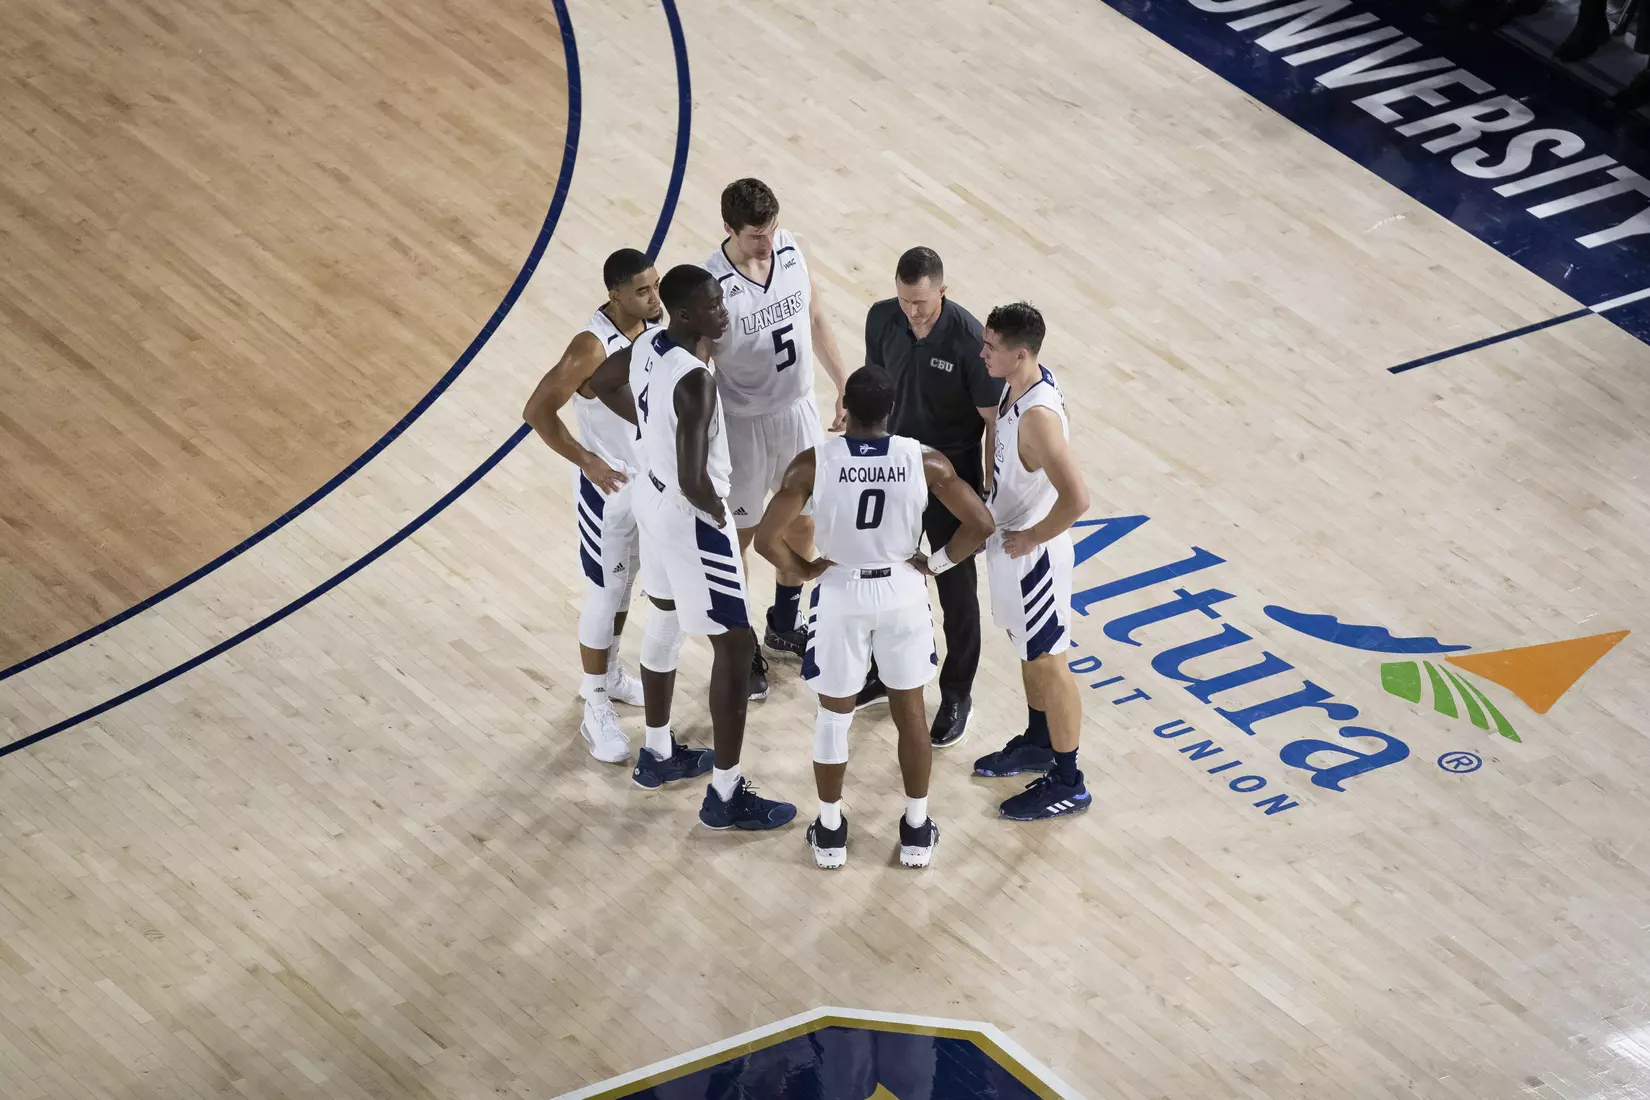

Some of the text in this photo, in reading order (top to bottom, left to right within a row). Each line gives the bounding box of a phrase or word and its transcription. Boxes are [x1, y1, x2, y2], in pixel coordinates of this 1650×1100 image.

[742, 291, 803, 335] LANCERS
[772, 323, 796, 372] 5
[929, 357, 954, 373] CBU
[839, 466, 906, 483] ACQUAAH
[856, 489, 886, 530] 0
[1068, 639, 1300, 816] DIT UNION
